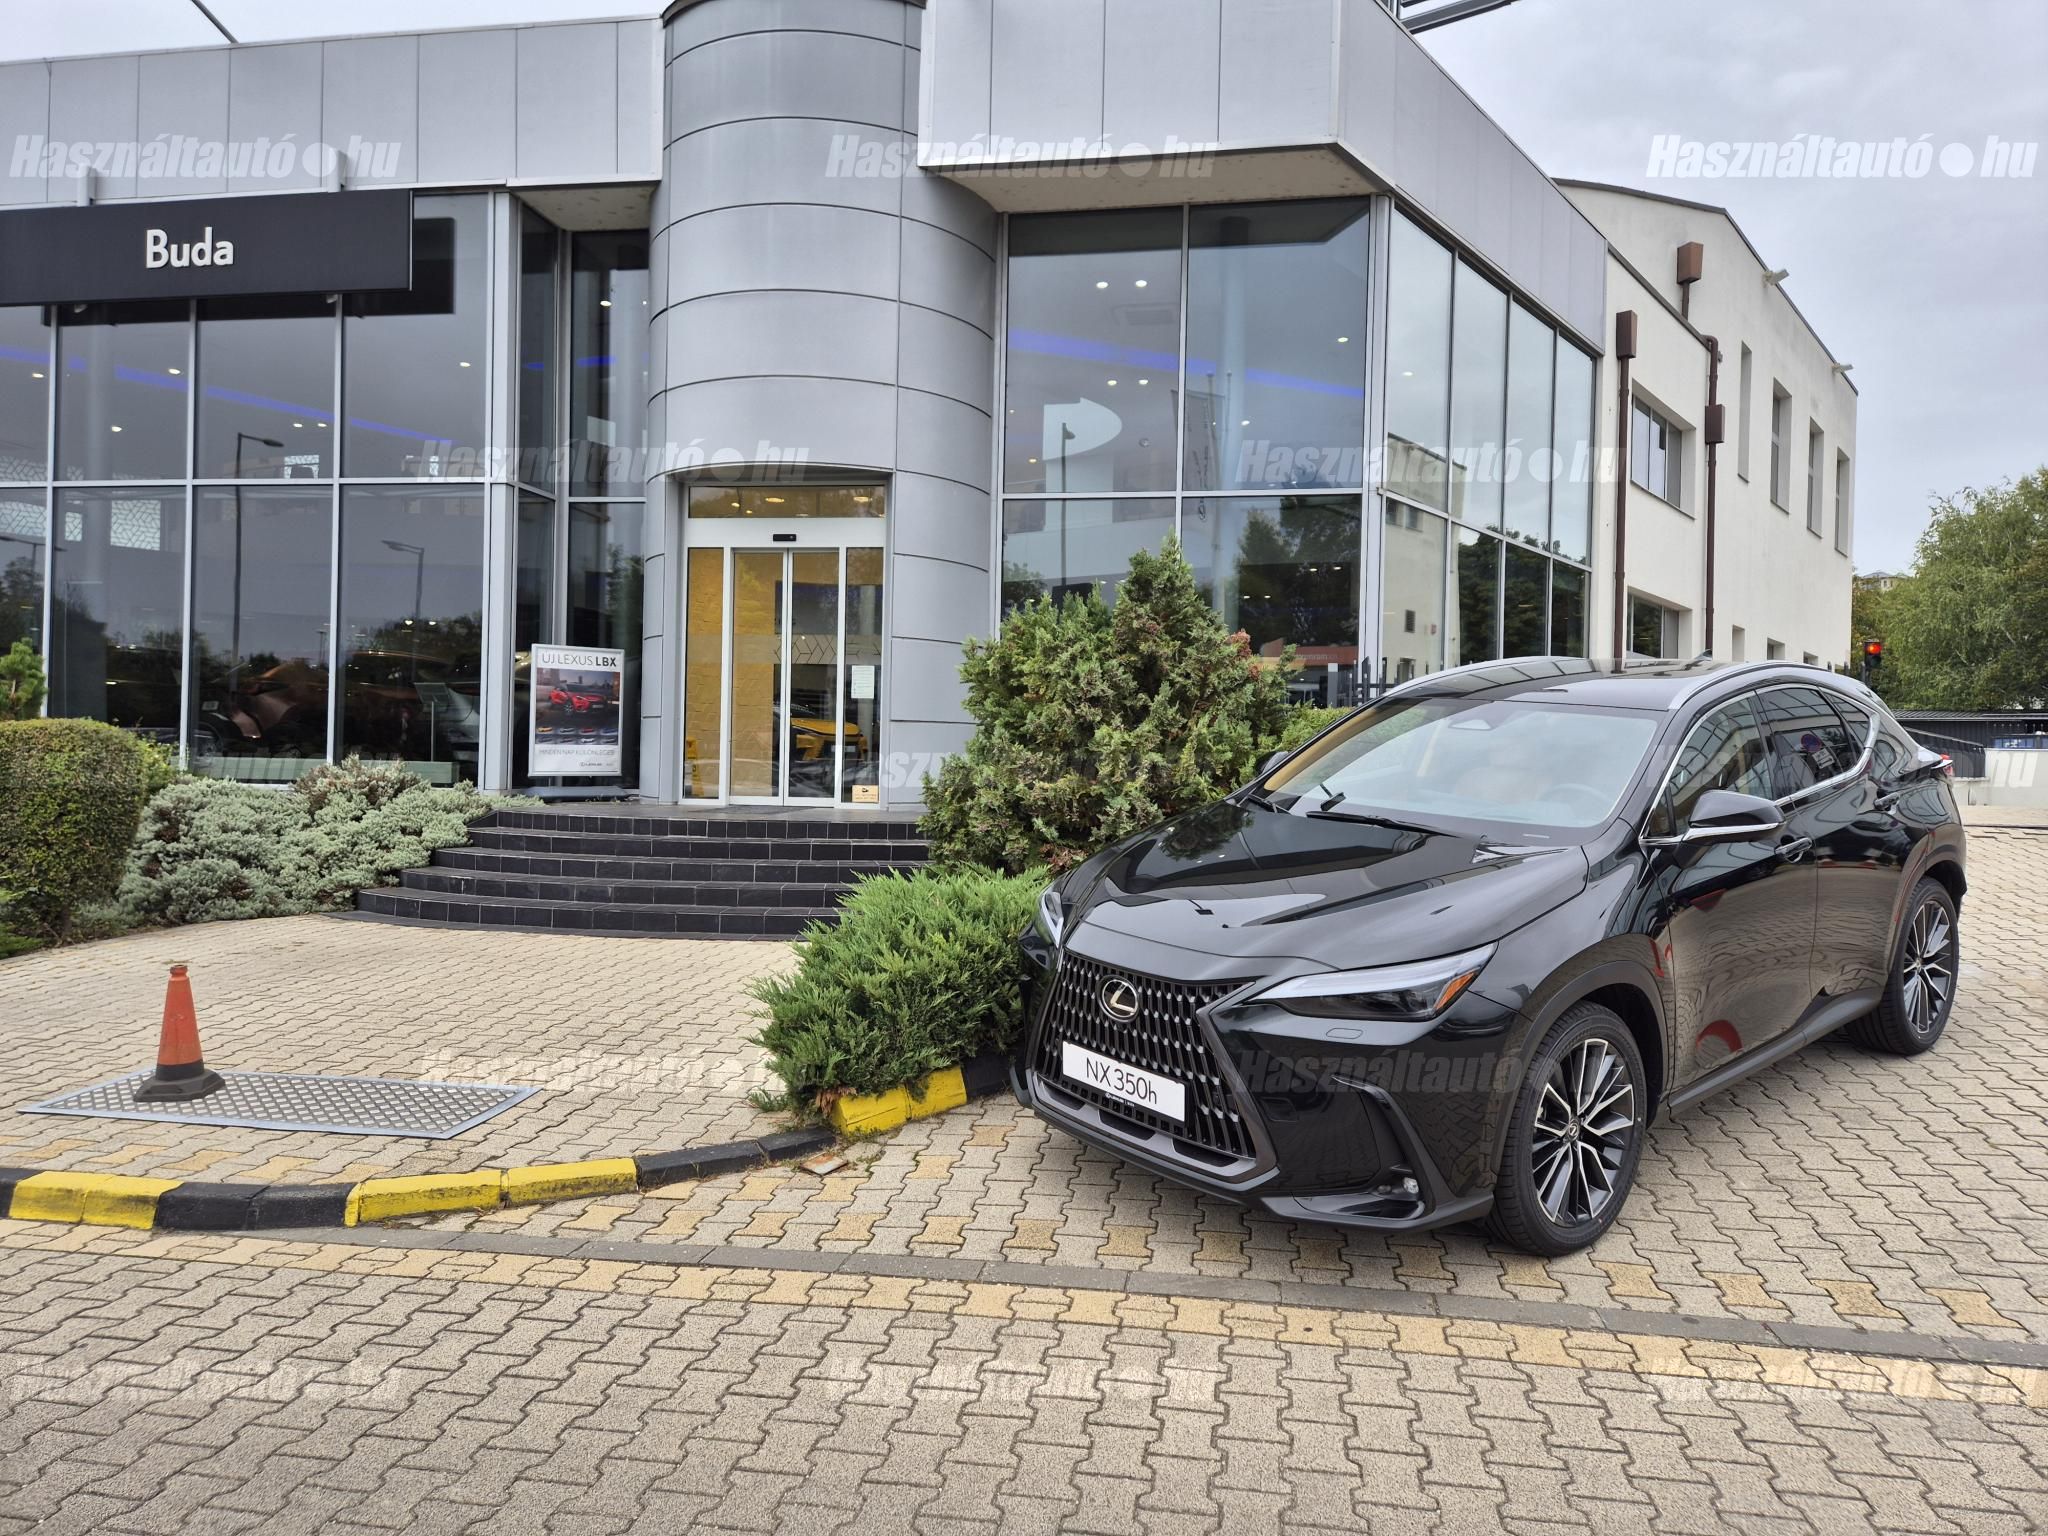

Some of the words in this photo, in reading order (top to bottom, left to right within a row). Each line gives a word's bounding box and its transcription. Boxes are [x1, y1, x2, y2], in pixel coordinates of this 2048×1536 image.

[146, 226, 235, 269] Buda
[557, 653, 593, 666] LEXUS
[595, 656, 617, 668] LBX
